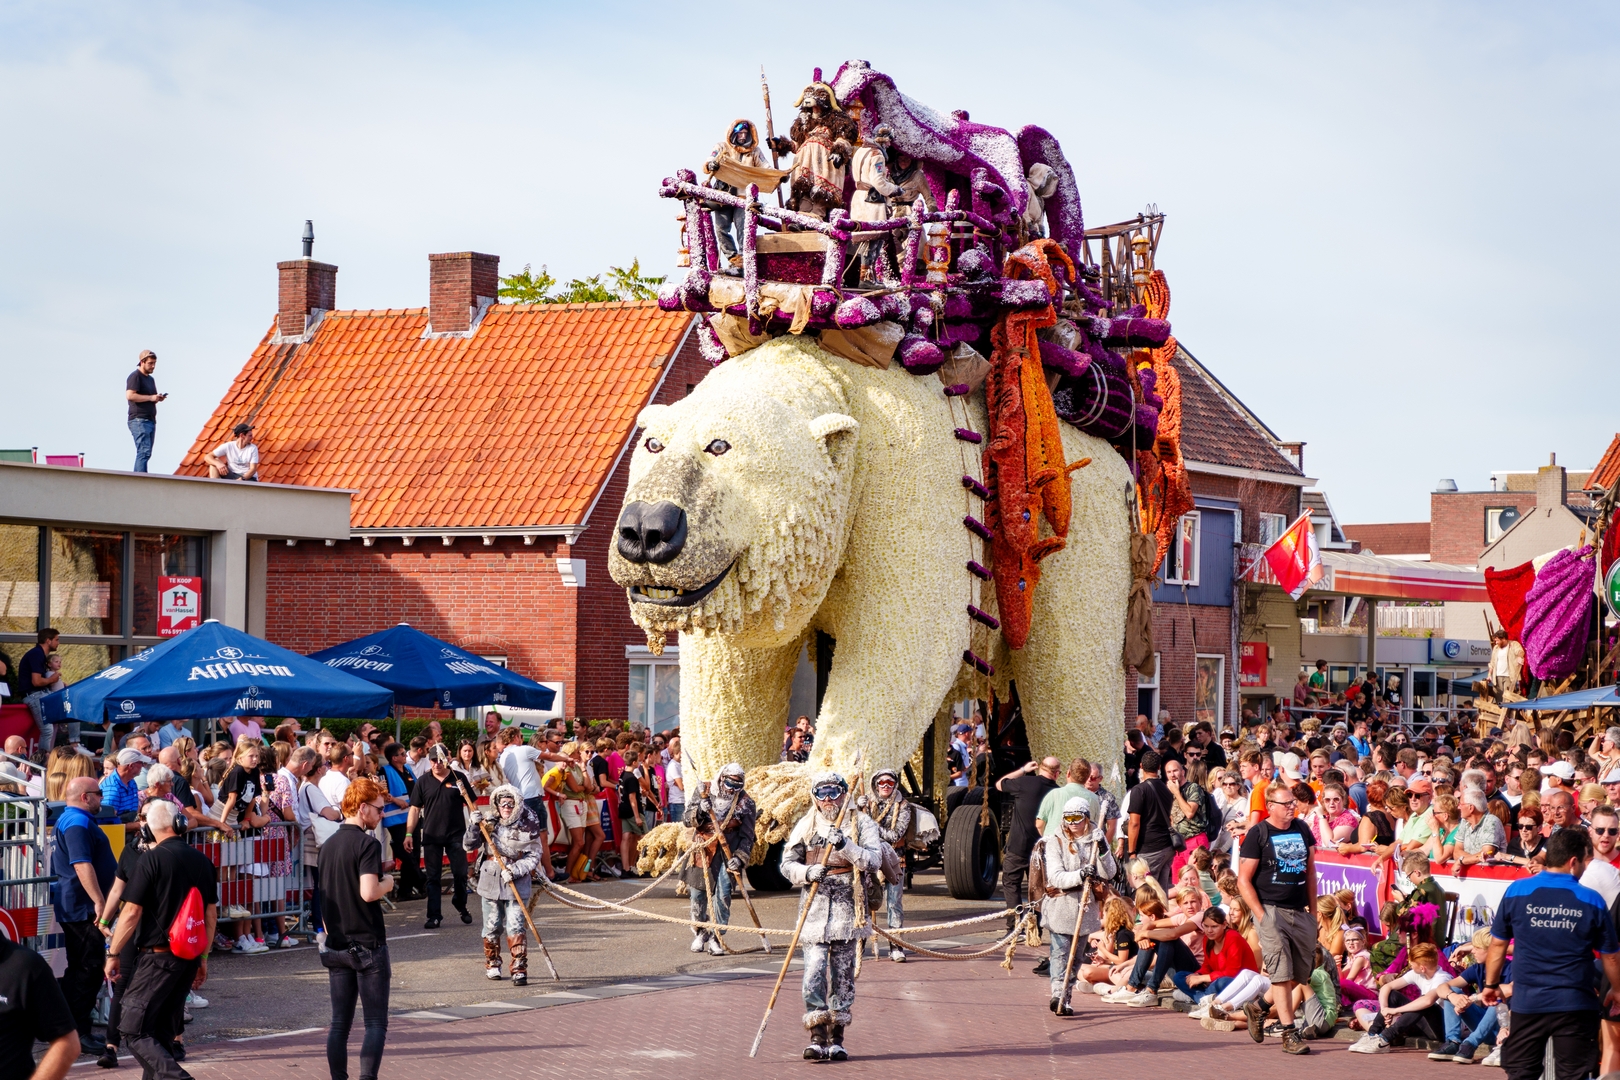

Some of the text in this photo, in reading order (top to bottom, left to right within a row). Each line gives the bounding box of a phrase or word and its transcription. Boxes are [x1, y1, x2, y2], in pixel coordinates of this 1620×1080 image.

[1470, 645, 1491, 656] Service
[187, 660, 296, 681] Affligem
[323, 656, 394, 672] Affligem
[234, 698, 273, 711] Affligem
[1526, 903, 1583, 918] Scorpions
[1530, 916, 1577, 933] Security
